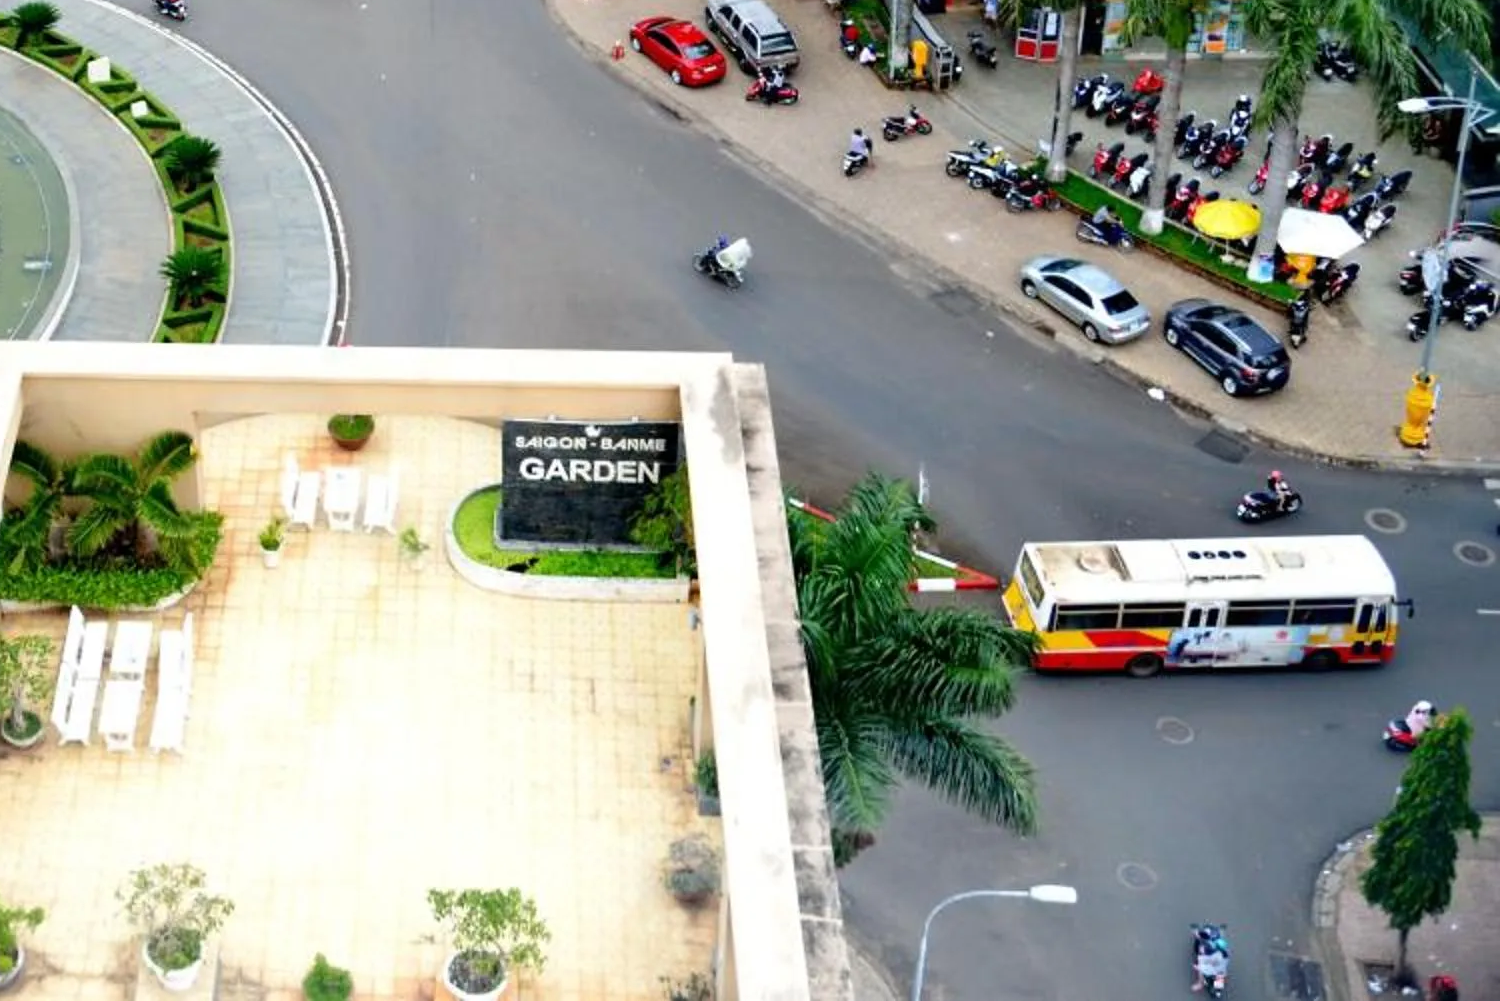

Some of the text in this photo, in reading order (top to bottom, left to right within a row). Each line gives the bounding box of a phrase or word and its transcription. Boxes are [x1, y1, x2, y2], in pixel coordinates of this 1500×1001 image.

[515, 436, 587, 449] SAIGON
[601, 438, 667, 452] BANME
[519, 456, 662, 484] GARDEN
